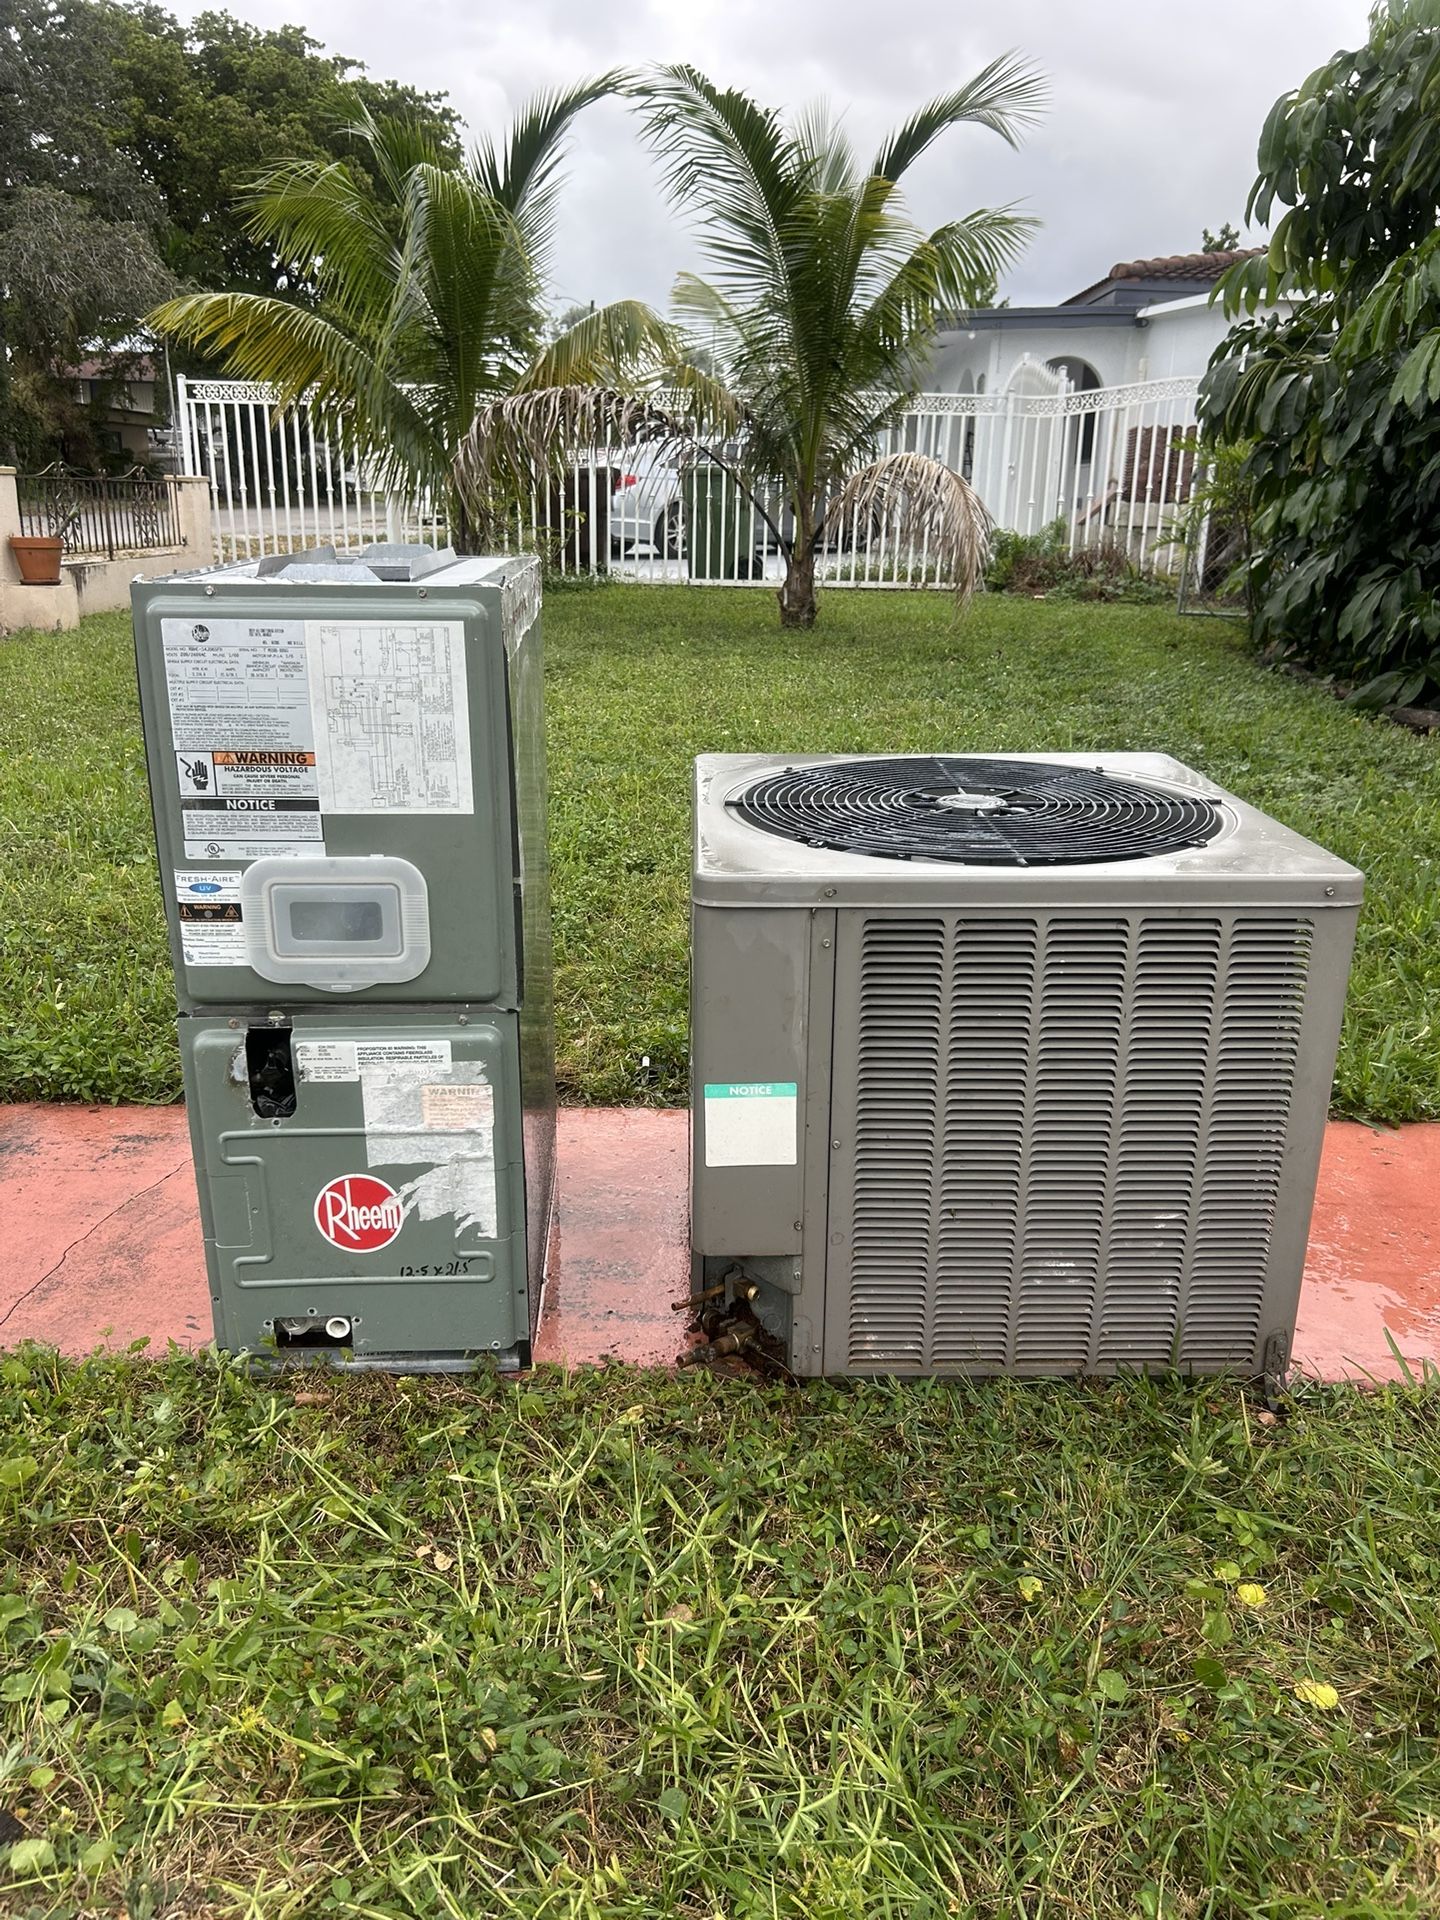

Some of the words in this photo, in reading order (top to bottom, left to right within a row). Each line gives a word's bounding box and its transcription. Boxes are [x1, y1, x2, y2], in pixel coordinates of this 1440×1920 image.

[235, 752, 308, 764] WARNING
[226, 800, 276, 810] NOTICE
[729, 1085, 773, 1096] NOTICE
[324, 1179, 400, 1241] Rheem
